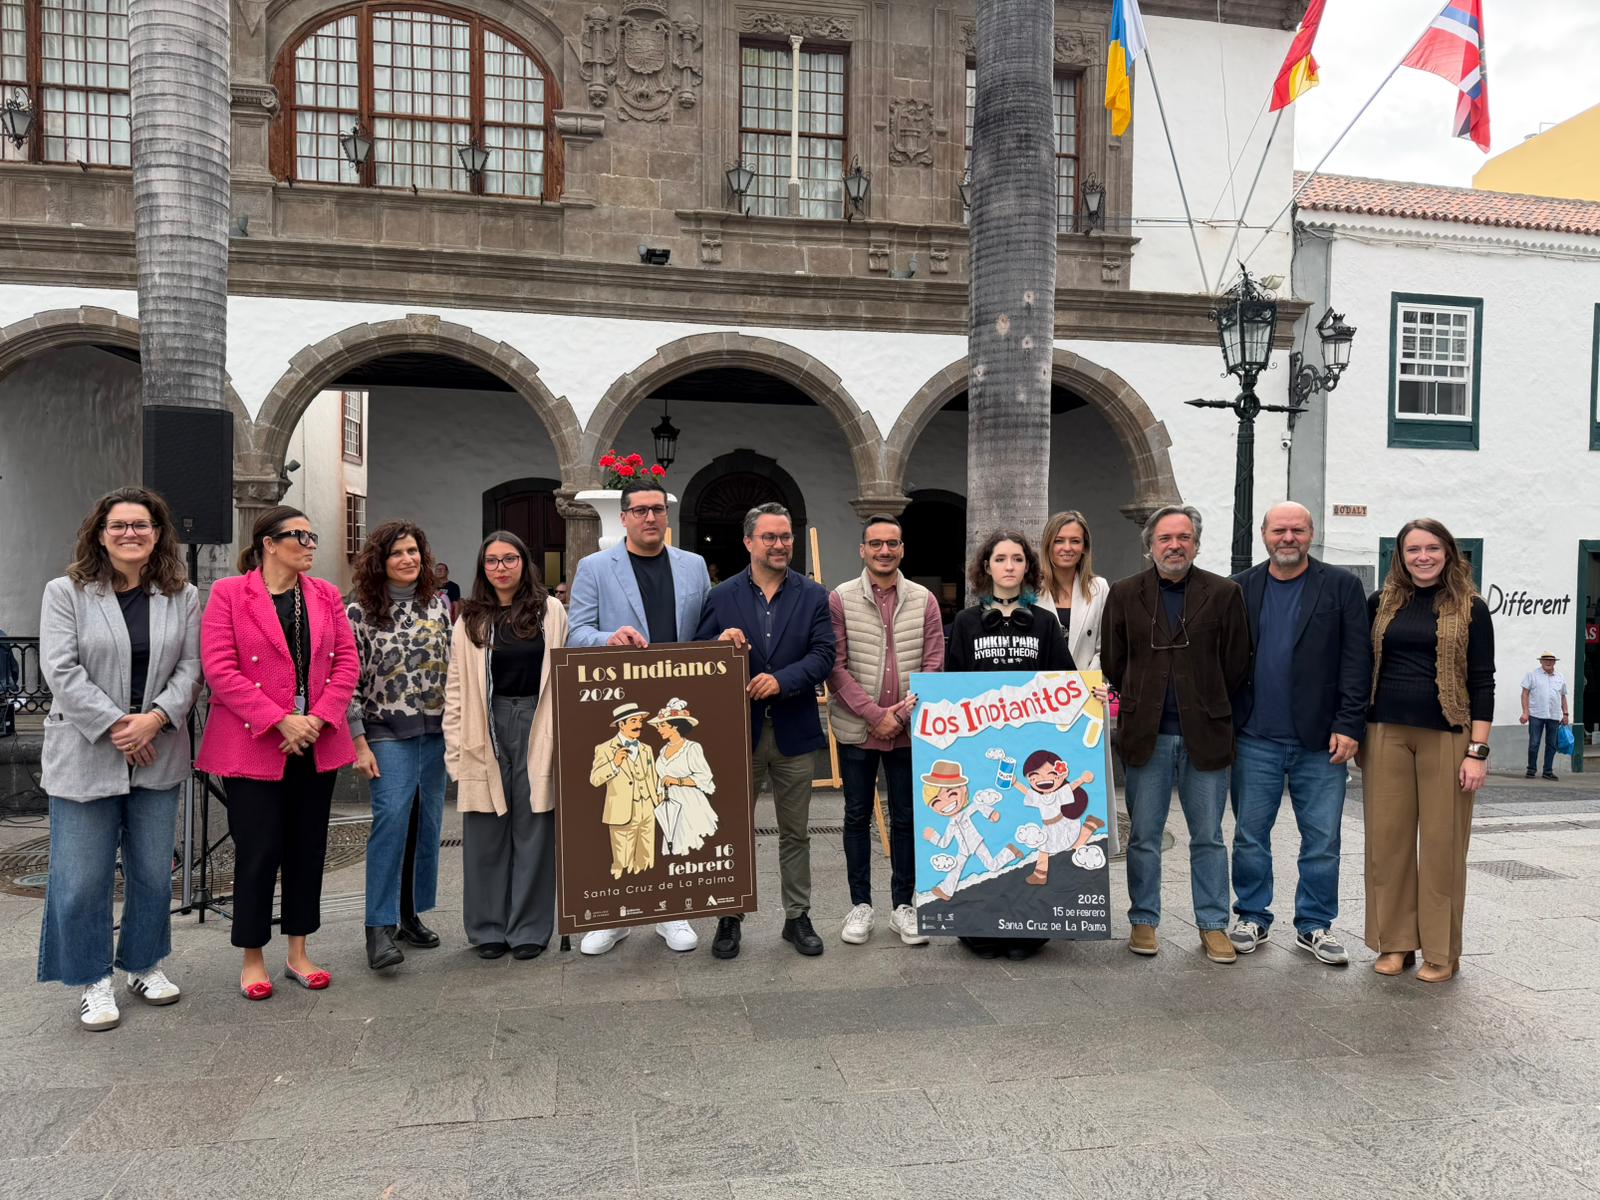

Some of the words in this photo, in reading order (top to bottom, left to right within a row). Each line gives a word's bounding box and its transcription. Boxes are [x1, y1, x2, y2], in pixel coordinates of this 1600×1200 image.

[1487, 584, 1571, 616] Different
[974, 636, 1010, 651] LINKIN
[1012, 636, 1039, 651] PARK
[974, 648, 1006, 660] HYBRID
[1008, 648, 1039, 660] THEORY
[578, 665, 617, 683] Los
[623, 660, 727, 680] Indianos
[579, 687, 625, 702] 2026
[920, 709, 960, 736] Los
[715, 844, 734, 858] 16
[668, 859, 735, 876] febrero
[583, 888, 620, 899] Santa
[625, 885, 653, 894] Cruz
[658, 881, 673, 890] de
[679, 879, 692, 888] La
[698, 875, 734, 886] Palma
[1078, 894, 1106, 905] 2026
[1053, 907, 1064, 917] 15
[998, 919, 1023, 930] Santa
[1026, 920, 1048, 930] Cruz
[1065, 920, 1077, 931] La
[1081, 921, 1107, 931] Palma
